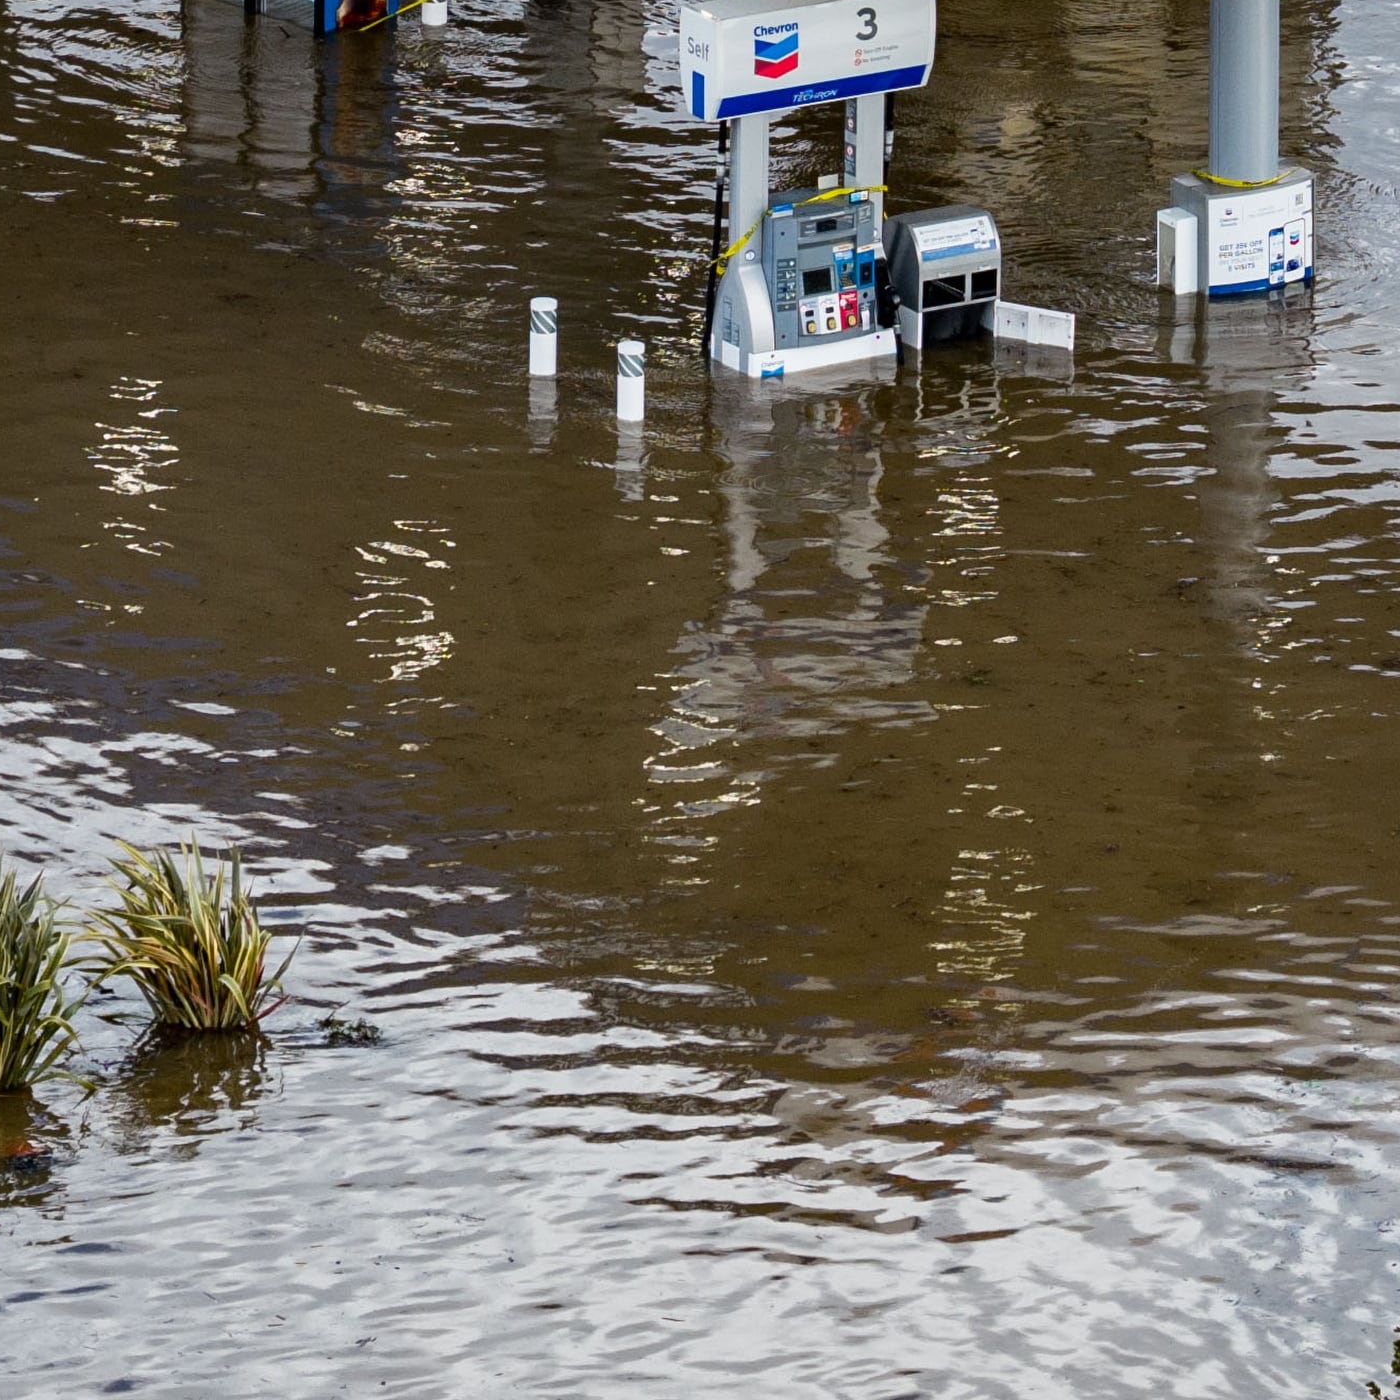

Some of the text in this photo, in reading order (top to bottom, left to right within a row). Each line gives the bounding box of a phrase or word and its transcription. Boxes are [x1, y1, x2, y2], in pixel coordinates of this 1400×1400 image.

[753, 21, 799, 38] Chevron
[855, 7, 878, 41] 3
[687, 37, 710, 62] Self
